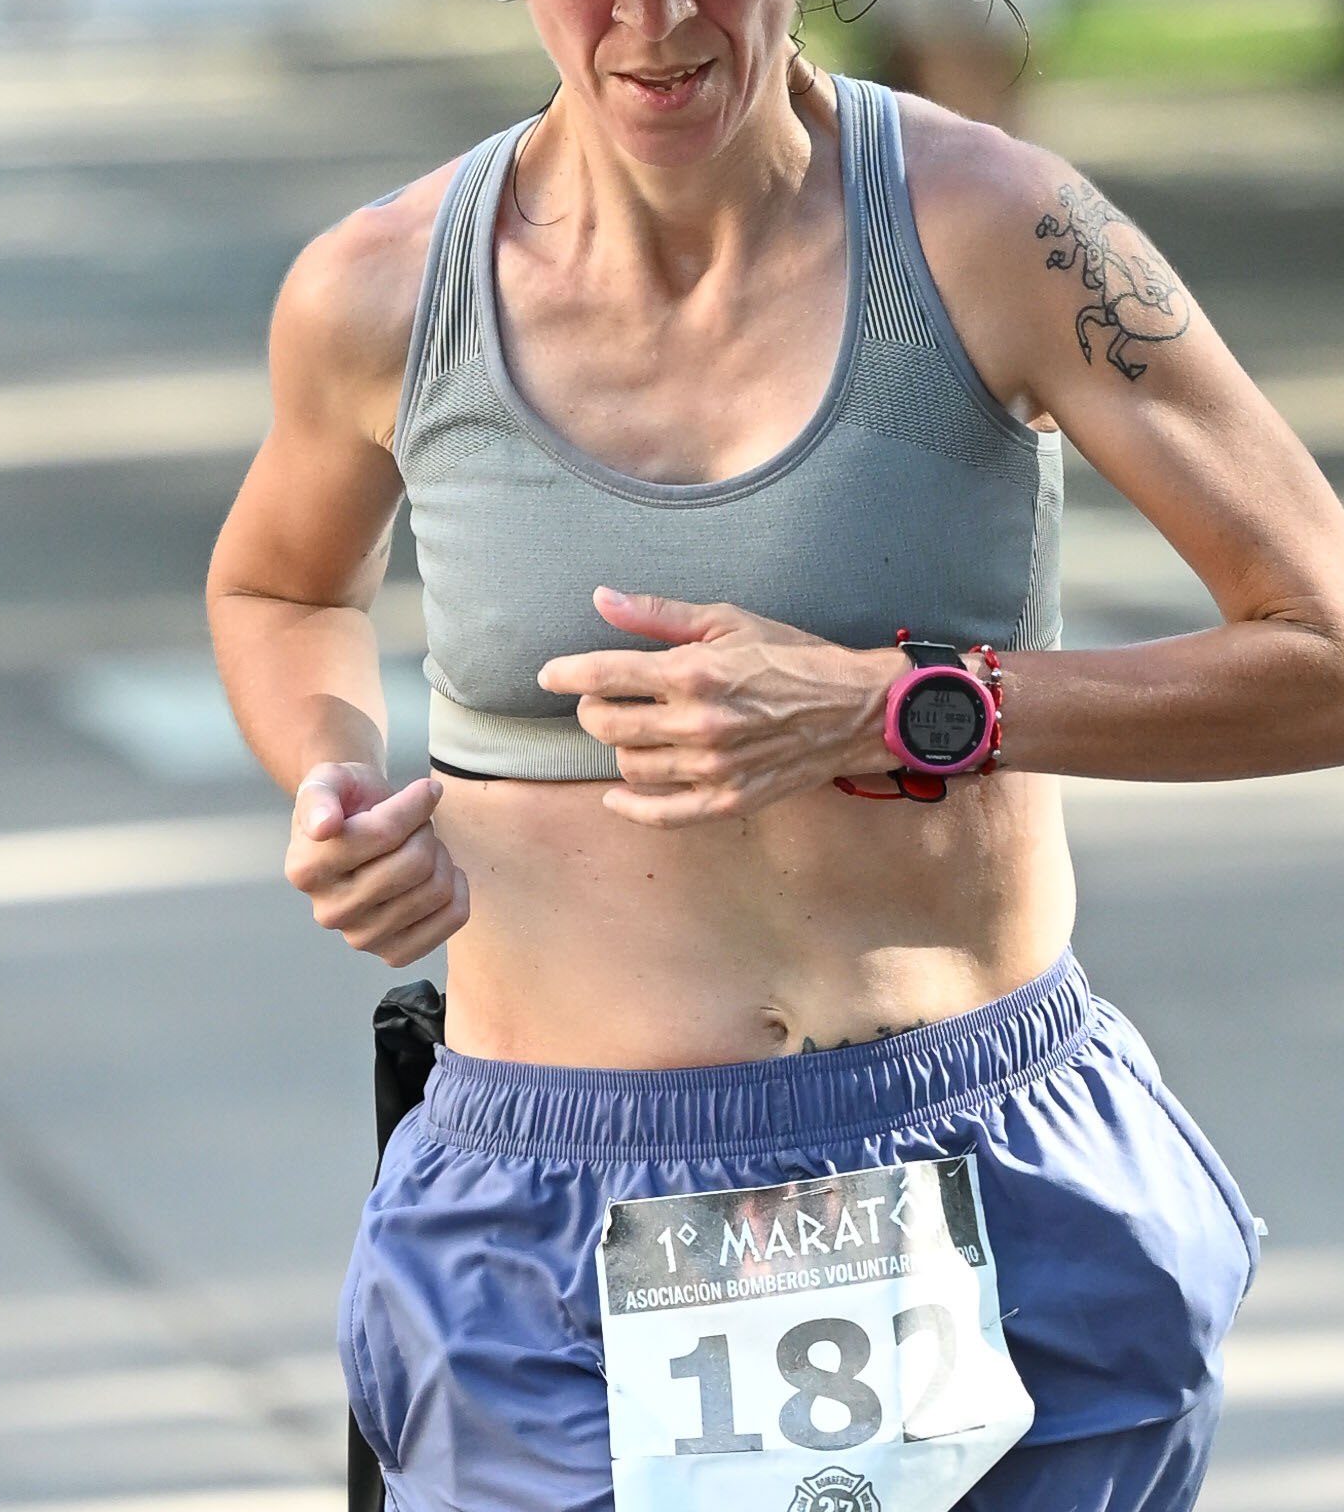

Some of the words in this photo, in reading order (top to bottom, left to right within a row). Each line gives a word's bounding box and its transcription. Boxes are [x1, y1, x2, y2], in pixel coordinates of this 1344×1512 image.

[719, 1177, 914, 1267] MARATÓ
[625, 1278, 723, 1311] ASOCIACIÓN
[726, 1266, 822, 1299] BOMBEROS
